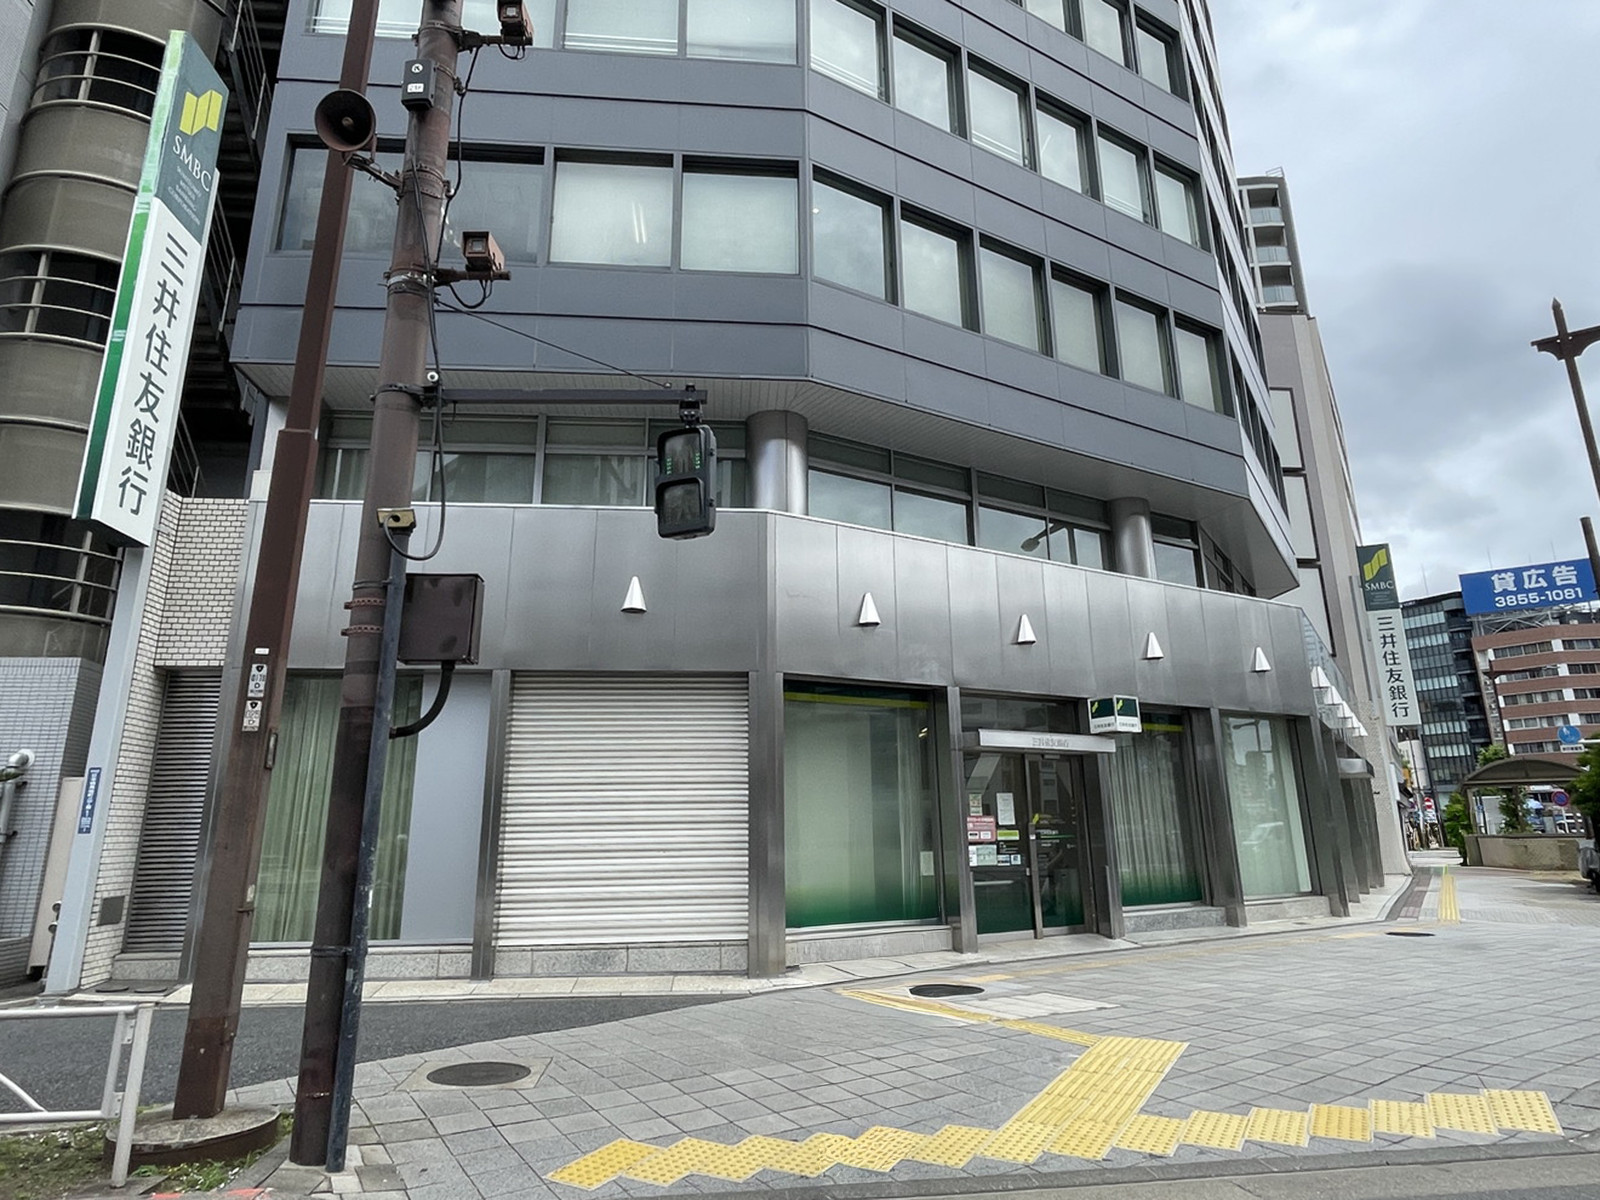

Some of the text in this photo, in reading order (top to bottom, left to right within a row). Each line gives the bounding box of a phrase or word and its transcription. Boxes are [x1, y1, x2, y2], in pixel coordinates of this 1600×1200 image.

[172, 135, 212, 192] SMBC
[118, 232, 188, 516] 三井住友銀行
[1364, 580, 1395, 592] SMBC
[1490, 565, 1578, 594] 貸広告
[1494, 587, 1583, 608] 3855-1081
[1377, 616, 1410, 719] 三井住友銀行
